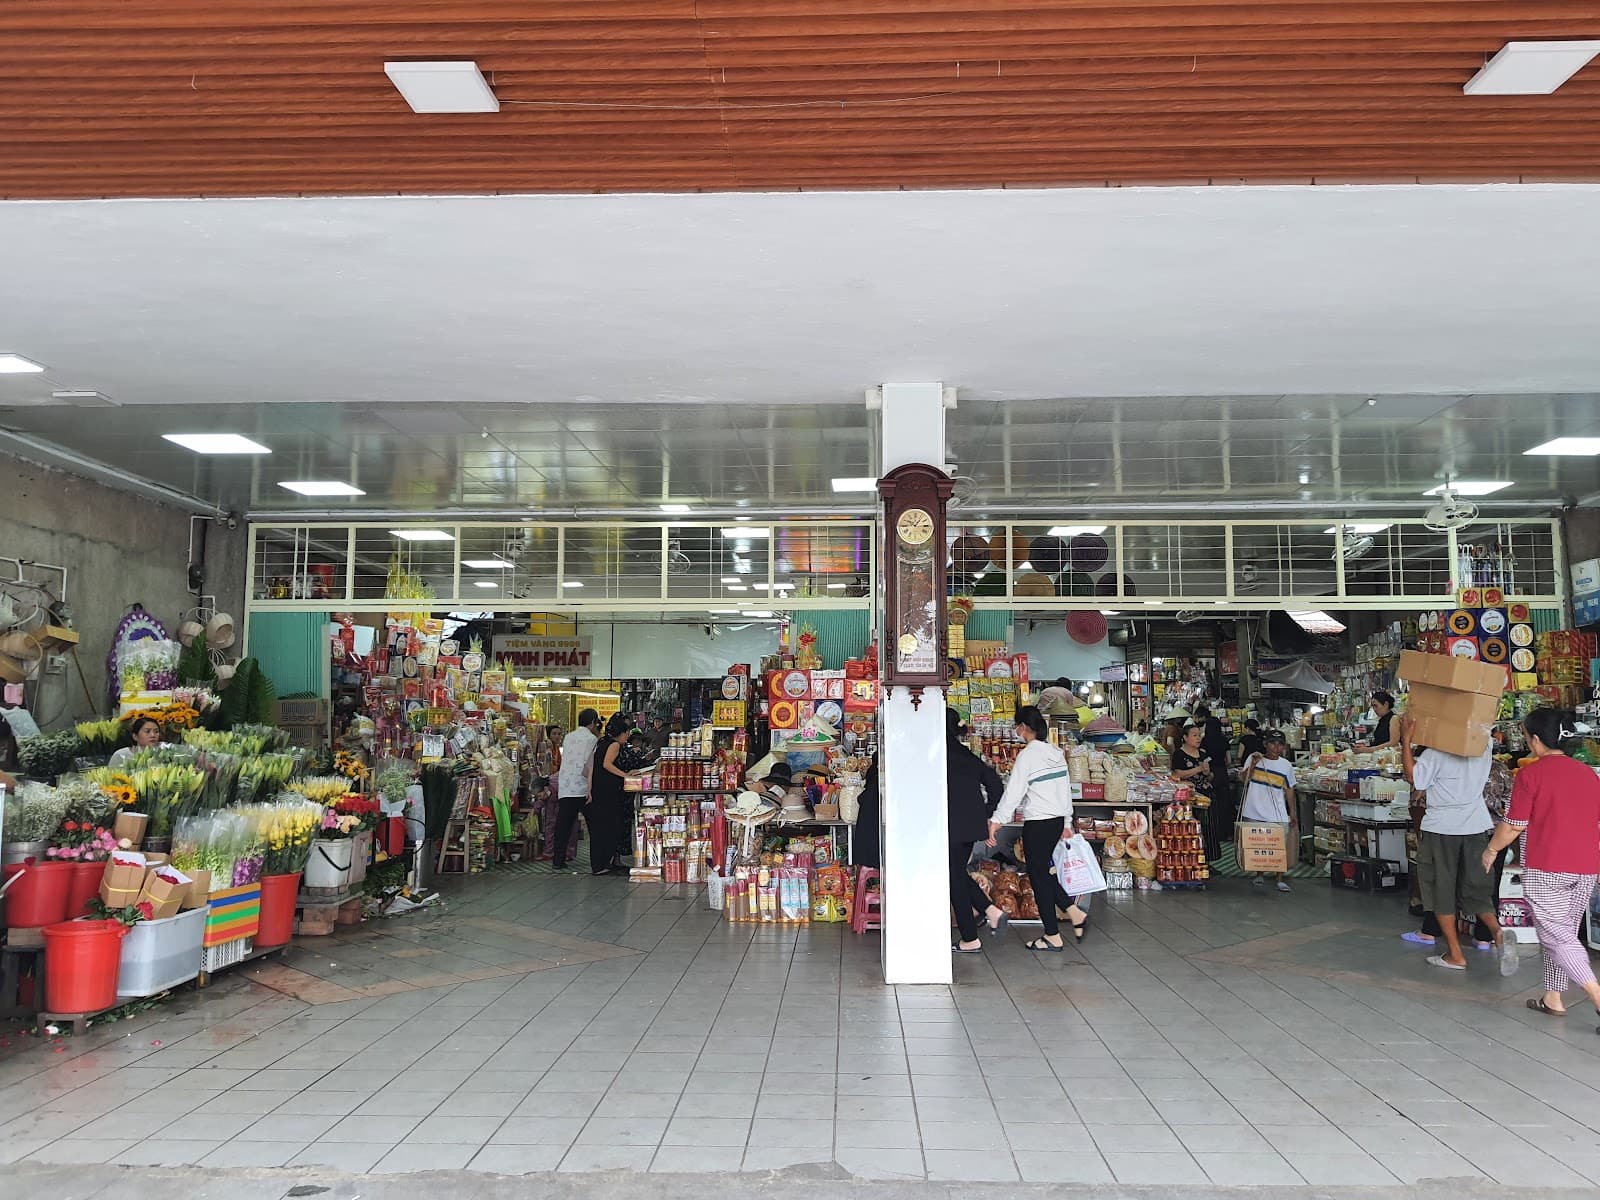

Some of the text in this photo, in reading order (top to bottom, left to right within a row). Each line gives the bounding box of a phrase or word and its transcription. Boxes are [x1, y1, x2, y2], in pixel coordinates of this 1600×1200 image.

[505, 639, 528, 648] TIỆM
[531, 638, 556, 648] VÀNG
[495, 648, 590, 666] MINH PHÁT
